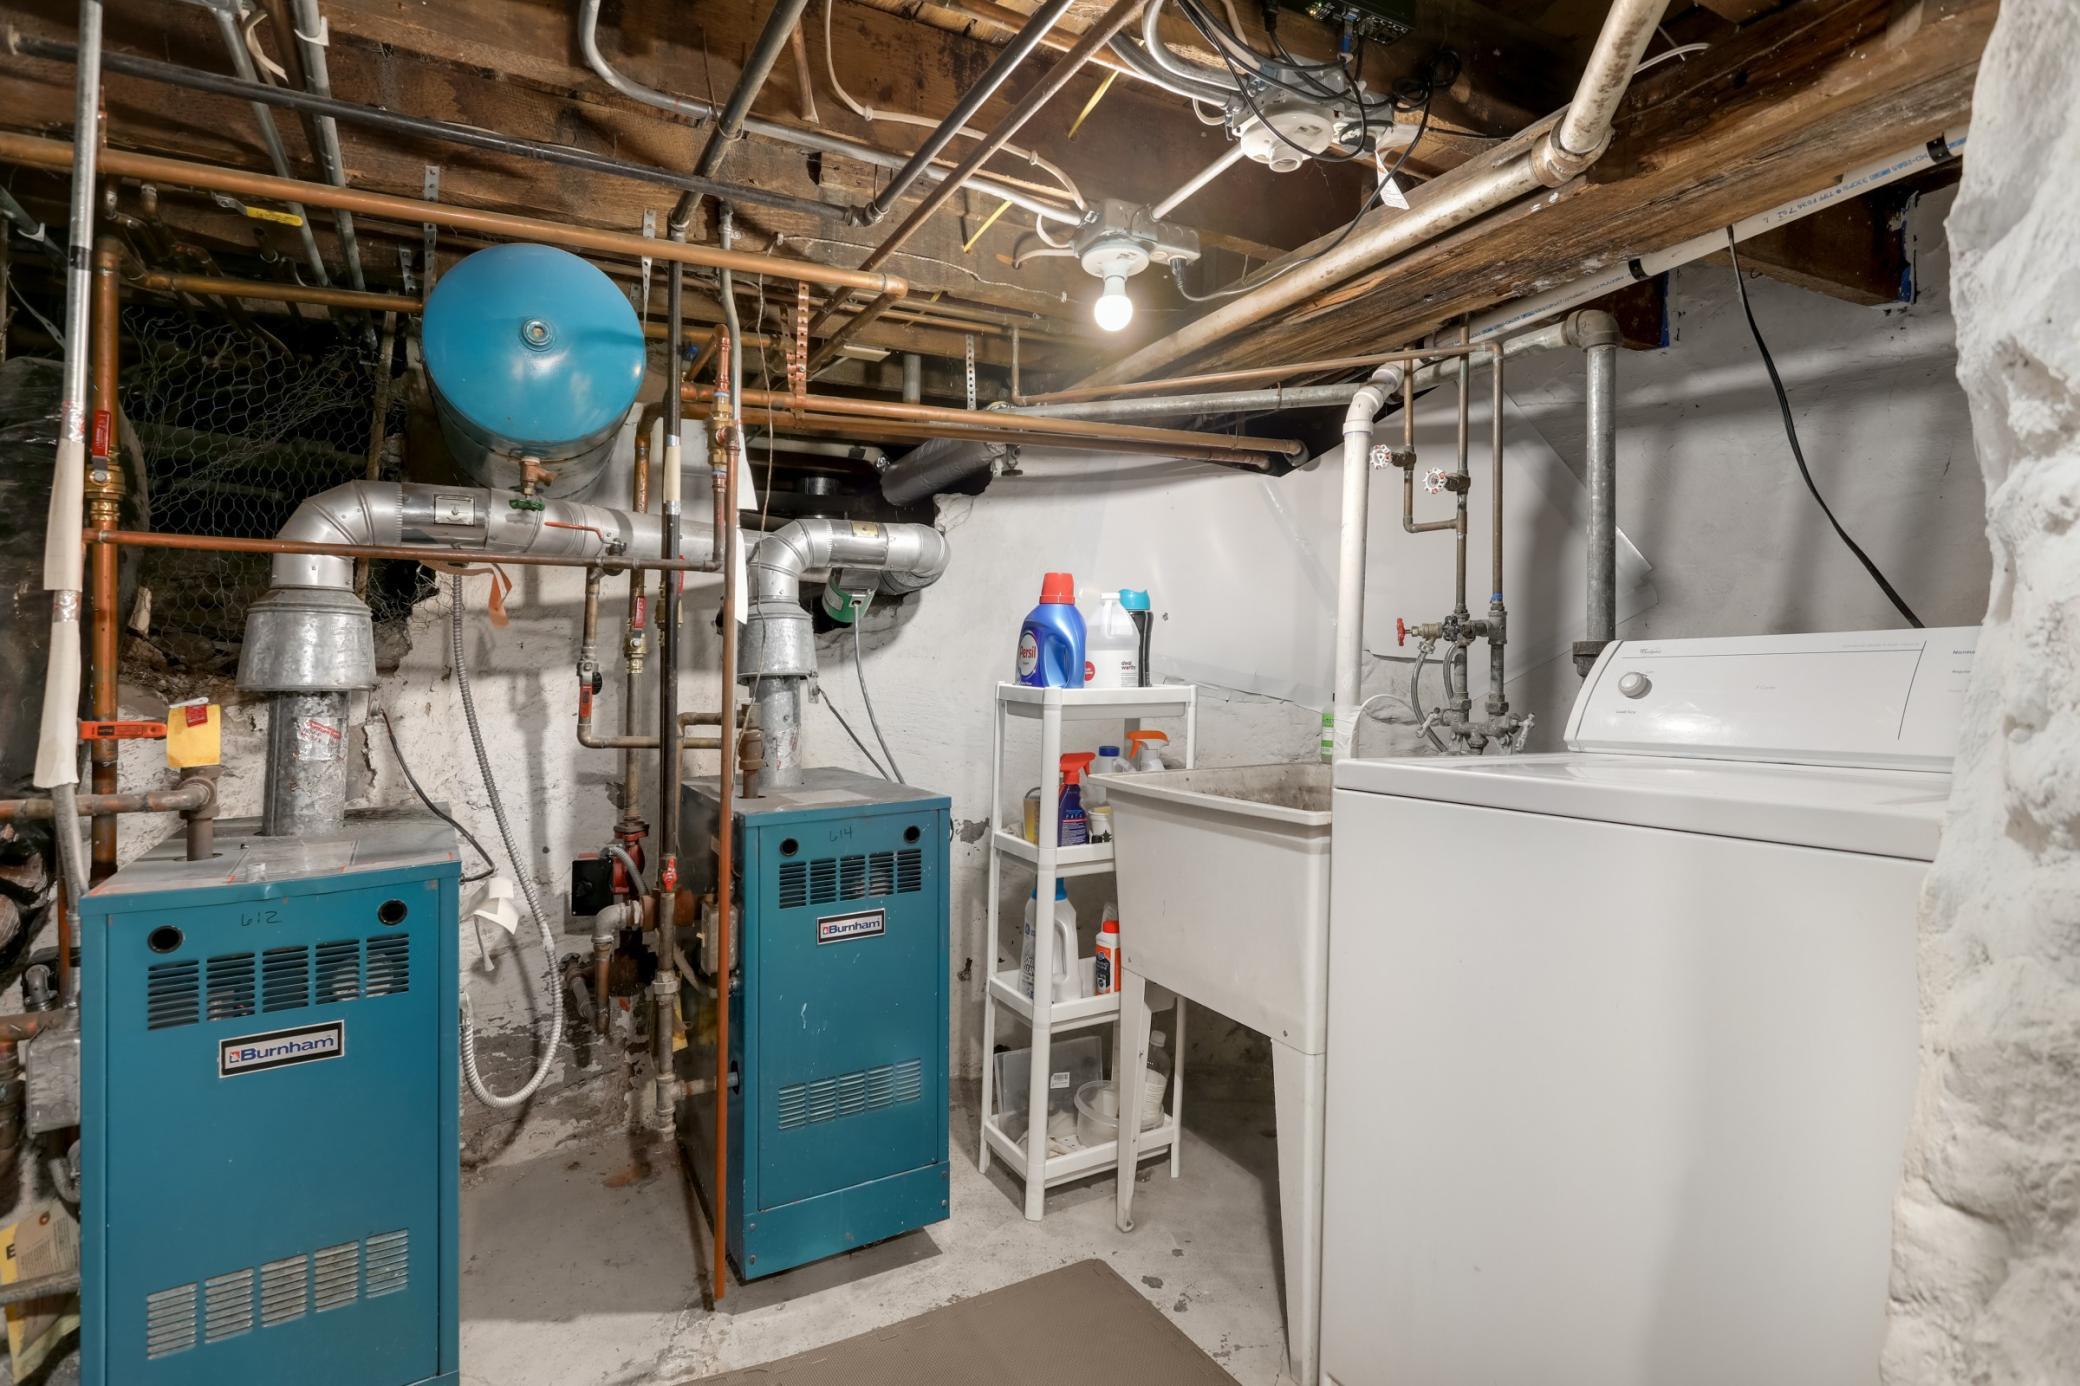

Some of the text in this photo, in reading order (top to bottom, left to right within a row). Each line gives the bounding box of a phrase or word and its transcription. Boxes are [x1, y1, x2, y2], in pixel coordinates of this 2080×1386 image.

[1019, 645, 1037, 659] Persil
[828, 825, 853, 842] 614
[240, 910, 283, 927] 612
[829, 920, 881, 934] Burnham
[241, 1036, 335, 1062] Burnham
